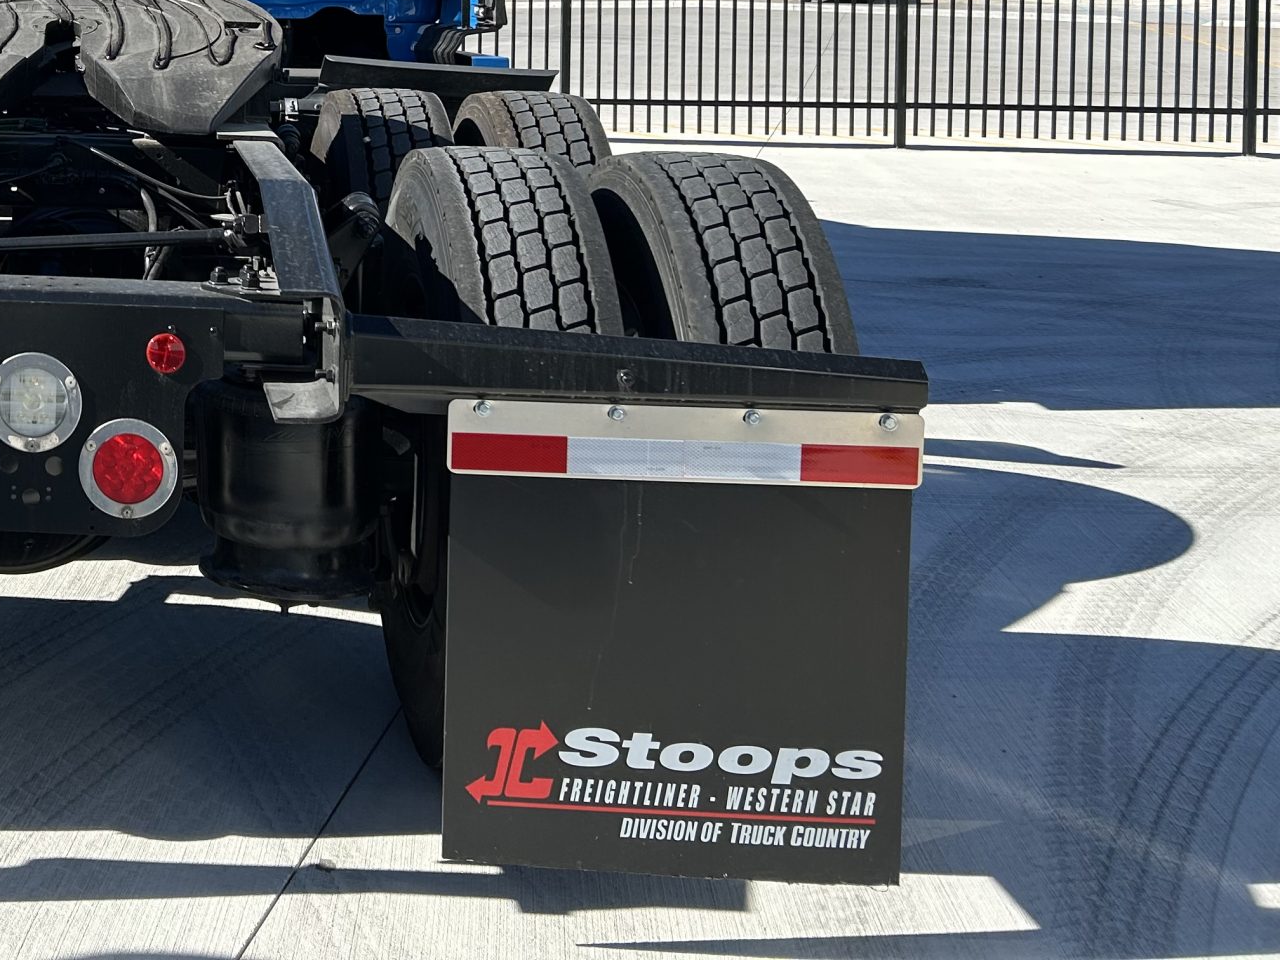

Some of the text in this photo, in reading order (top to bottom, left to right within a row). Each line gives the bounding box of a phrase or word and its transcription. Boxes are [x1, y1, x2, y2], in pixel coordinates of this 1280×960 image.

[558, 727, 884, 785] Stoops
[559, 777, 701, 809] FREIGHTLINER
[725, 785, 819, 814] WESTERN
[826, 790, 877, 816] STAR
[620, 817, 871, 850] DIVISION OF TRUCK COUNTRY
